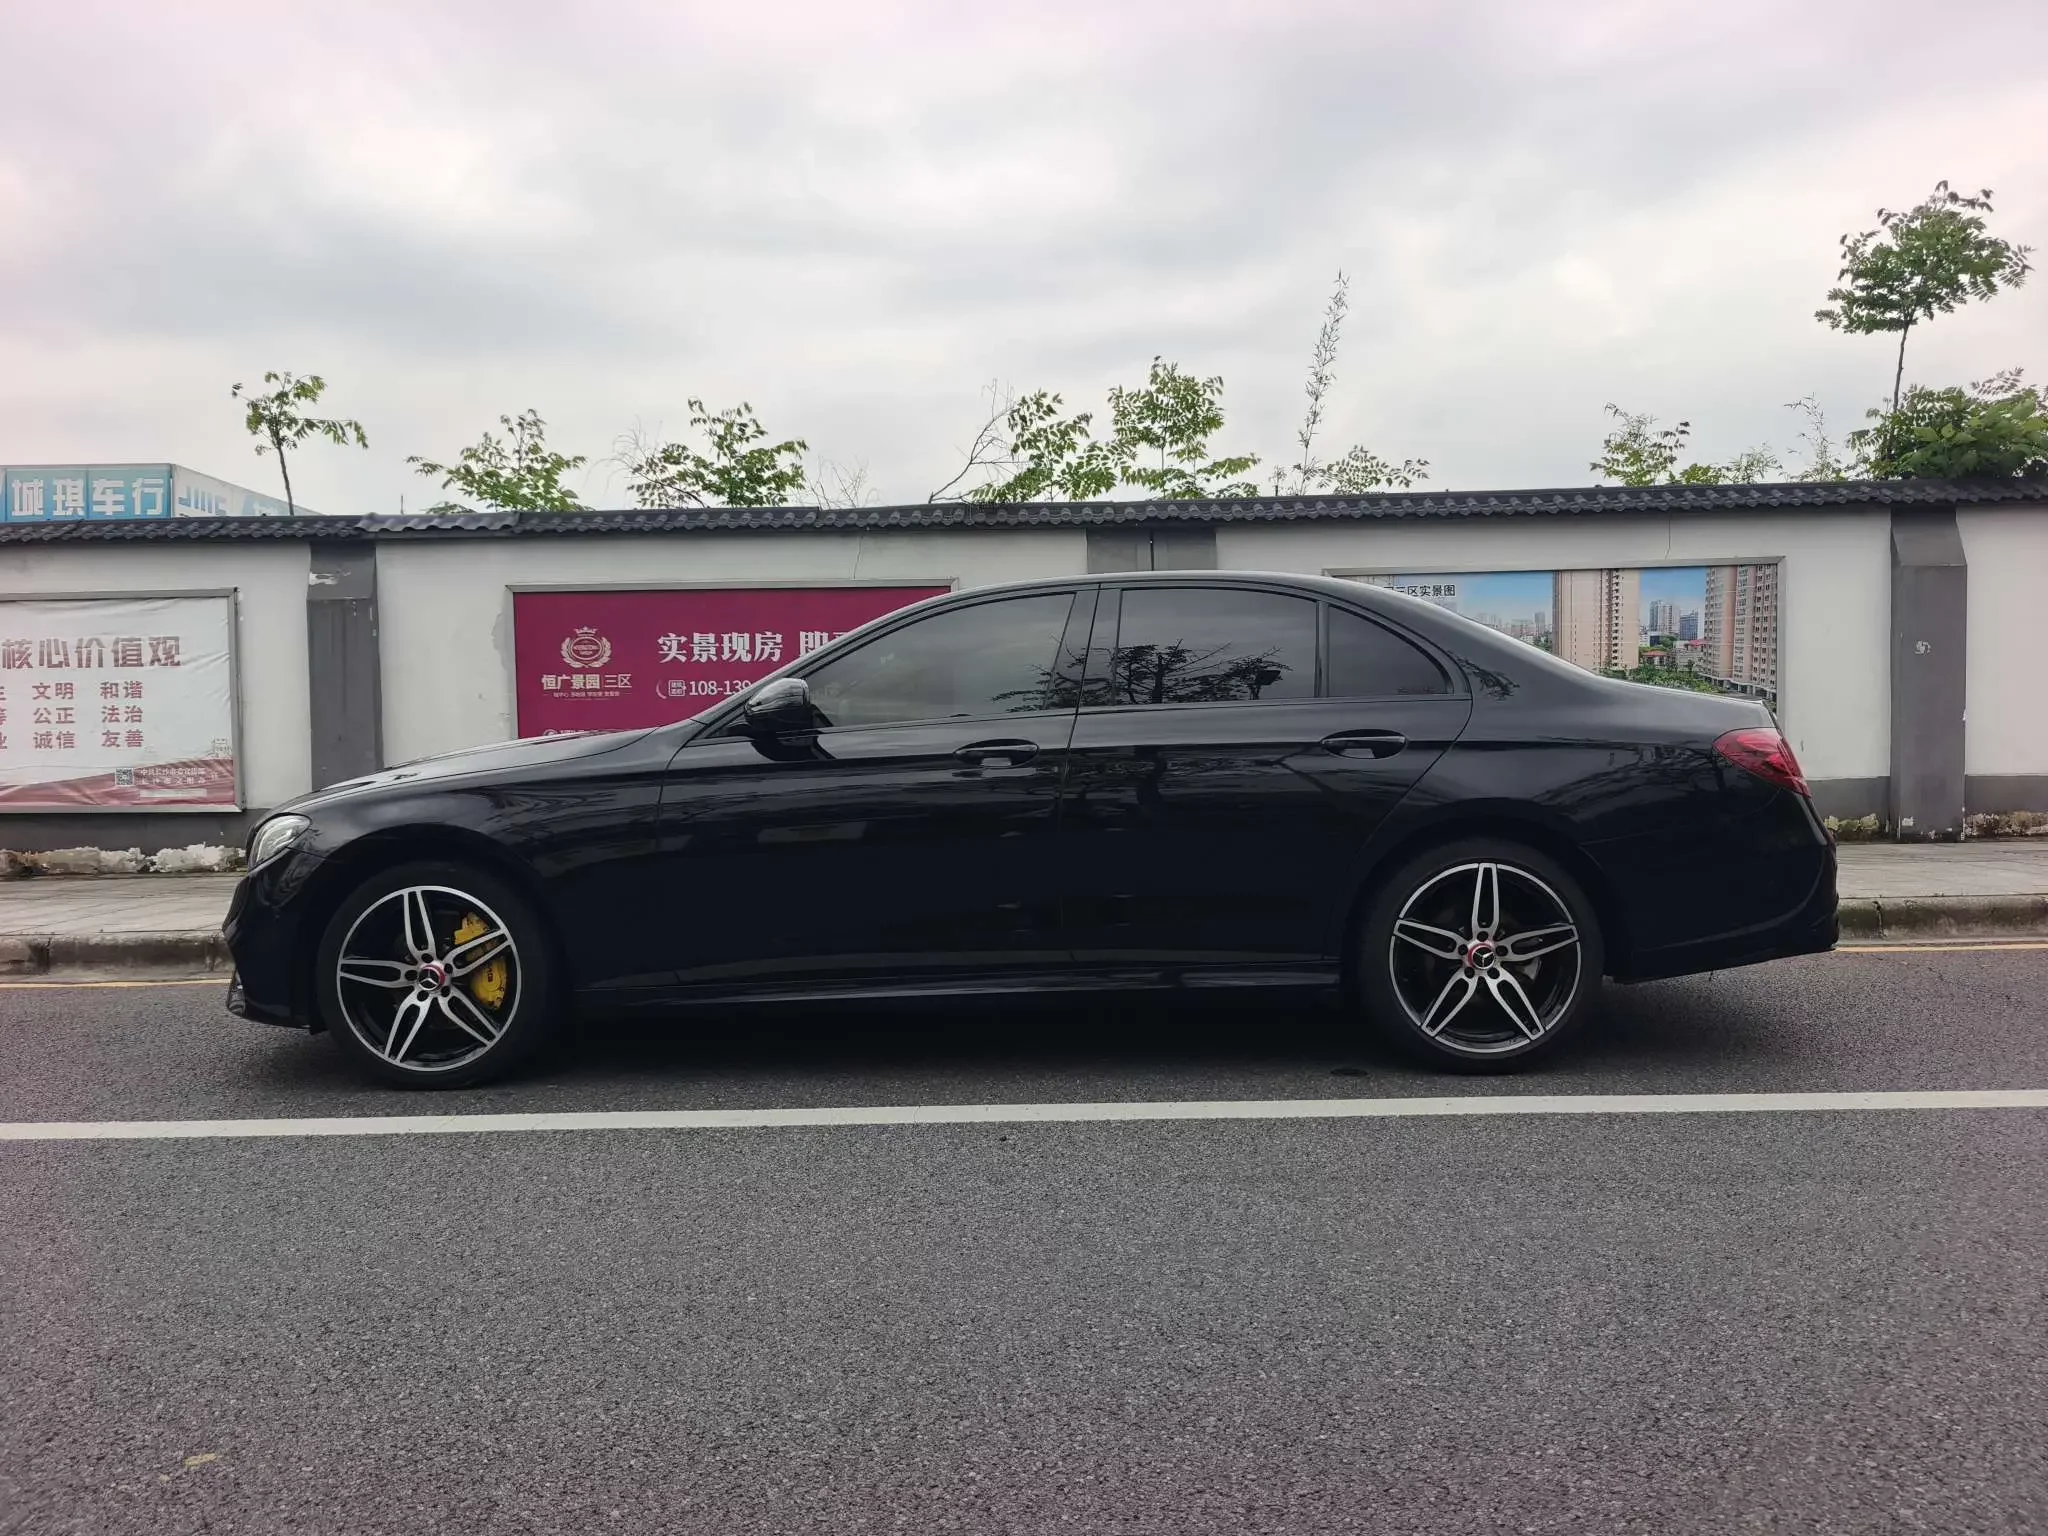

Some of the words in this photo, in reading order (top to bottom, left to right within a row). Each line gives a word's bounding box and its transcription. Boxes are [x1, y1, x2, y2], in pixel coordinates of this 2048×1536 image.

[1383, 584, 1456, 597] 三区实景图
[2, 636, 181, 669] 核心价值观
[657, 632, 783, 663] 实景现房
[32, 682, 75, 700] 文明
[100, 681, 144, 699] 和谐
[541, 674, 600, 690] 恒广景园
[604, 673, 633, 688] 三区
[33, 707, 76, 724] 公正
[101, 705, 143, 723] 法治
[34, 731, 76, 749] 诚信
[101, 729, 144, 747] 友善
